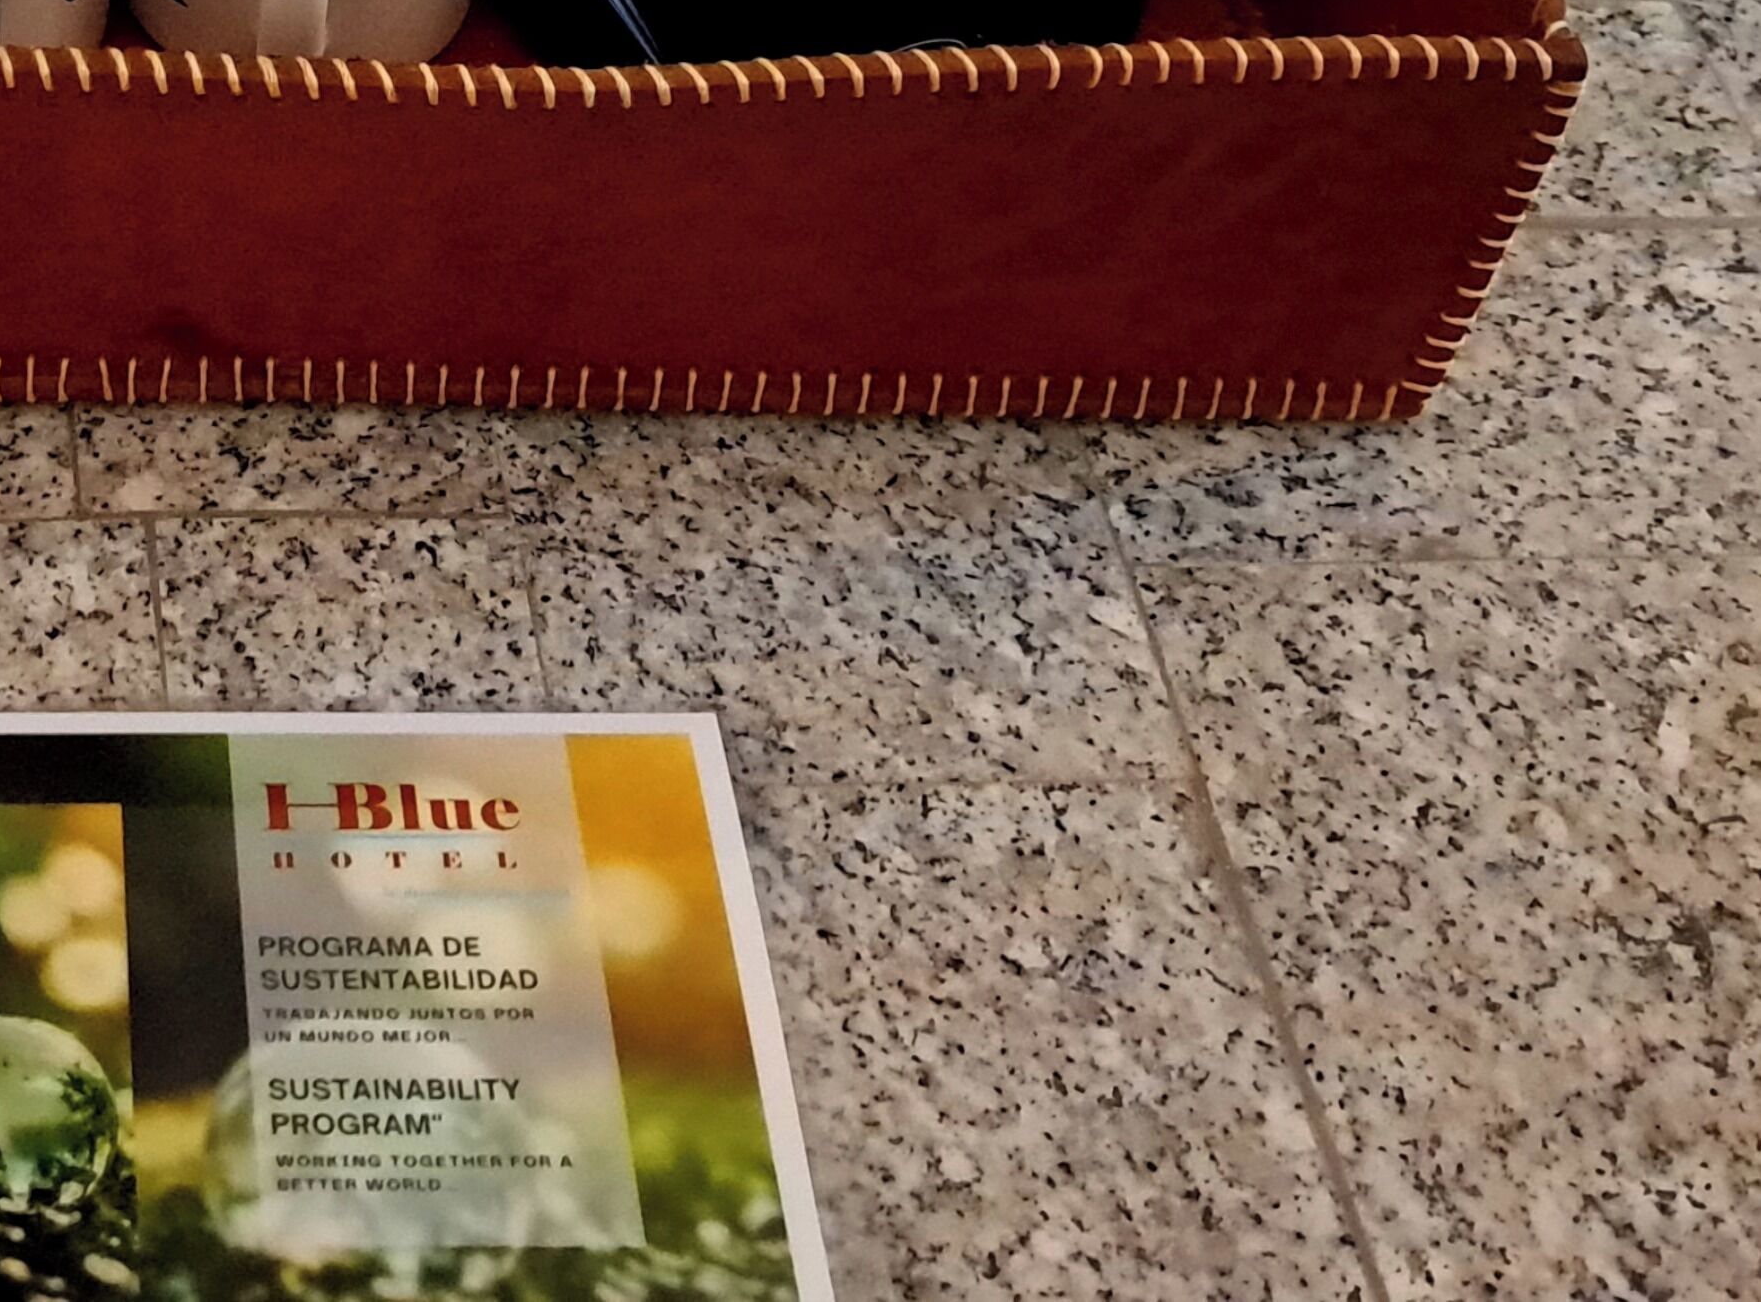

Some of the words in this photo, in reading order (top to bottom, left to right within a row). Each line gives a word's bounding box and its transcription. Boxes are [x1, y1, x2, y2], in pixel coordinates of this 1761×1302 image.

[263, 781, 522, 831] HBlue
[273, 851, 517, 870] HOTEL
[258, 935, 434, 958] PROGRAMA
[443, 935, 481, 957] DE
[260, 968, 540, 991] SUSTENTABILIDAD
[262, 1008, 401, 1021] TRABAJANDO
[409, 1007, 487, 1021] JUNTOS
[493, 1007, 535, 1020] POR
[264, 1029, 292, 1043] UN
[298, 1029, 375, 1043] MUNDO
[268, 1077, 520, 1101] SUSTAINABILITY
[276, 1154, 382, 1169] WORKING
[390, 1154, 503, 1169] TOGETHER
[510, 1154, 552, 1168] FOR
[559, 1154, 574, 1168] A
[276, 1178, 357, 1192] BETTER
